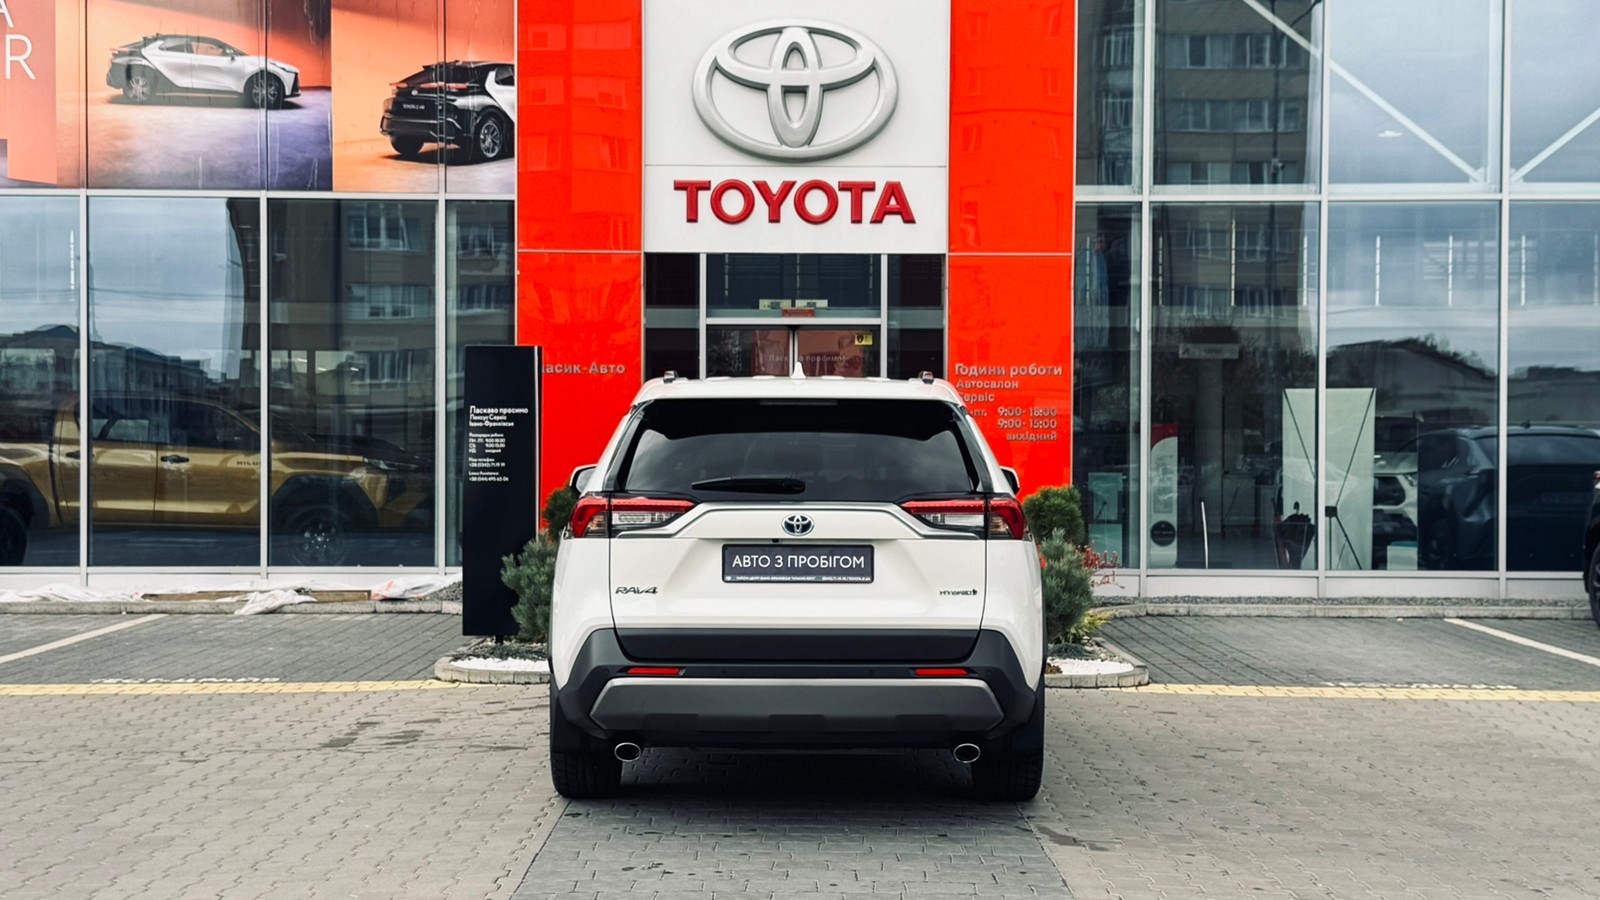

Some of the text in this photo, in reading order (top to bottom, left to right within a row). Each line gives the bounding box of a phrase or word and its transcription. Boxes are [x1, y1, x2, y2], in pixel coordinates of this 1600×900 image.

[673, 179, 917, 225] TOYOTA
[541, 361, 626, 374] асик-Авто
[955, 363, 1063, 378] Години роботи
[956, 380, 1019, 389] Автосалон
[469, 405, 529, 415] Ласкаво просимо
[1029, 406, 1058, 417] 18:00
[488, 413, 508, 421] Сервіс
[1029, 419, 1058, 429] 15:00
[1006, 431, 1058, 442] вихідний
[732, 554, 865, 568] АВТО З ПРОБІГОМ
[615, 586, 658, 594] RAV4
